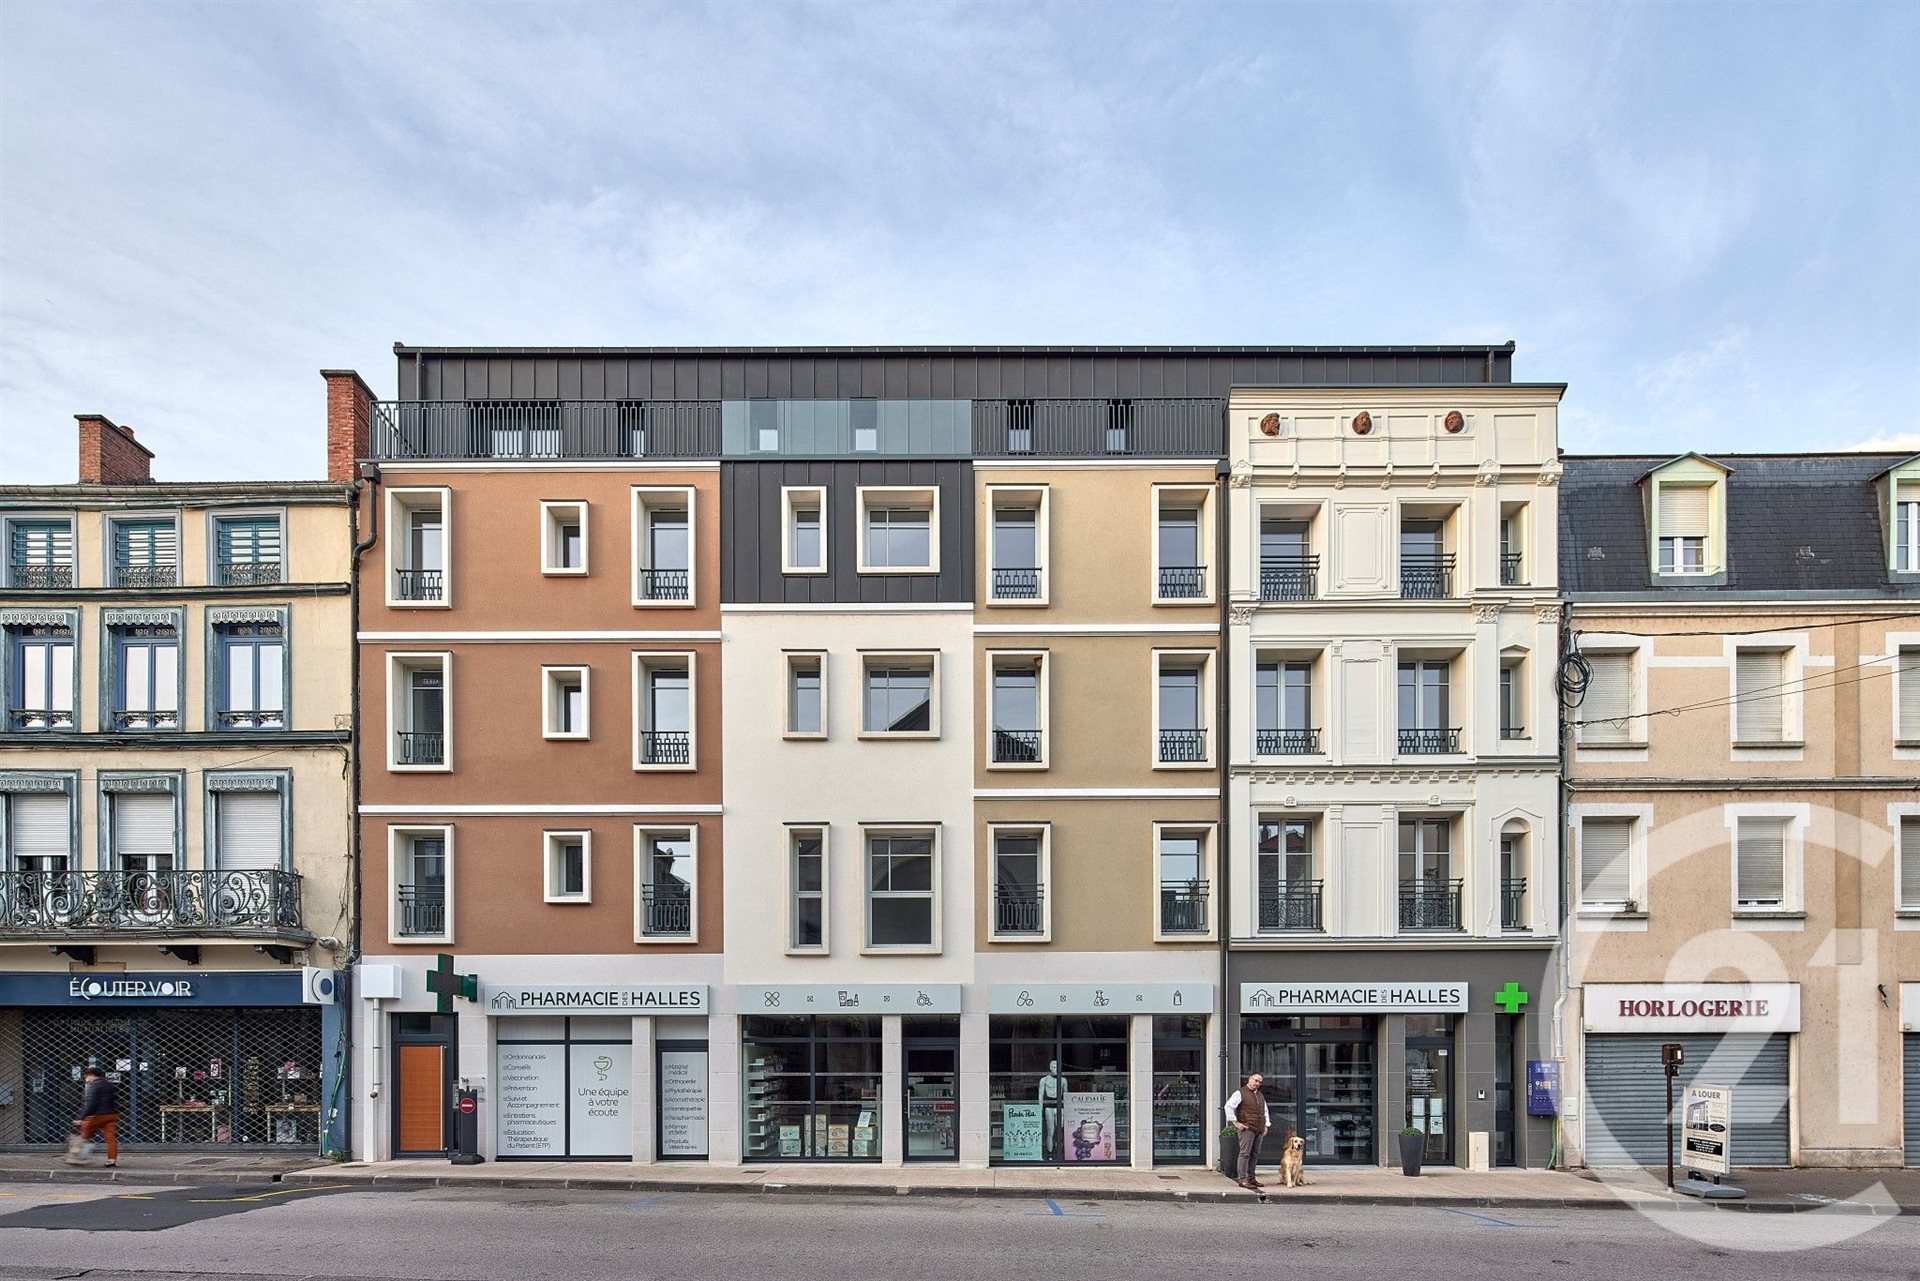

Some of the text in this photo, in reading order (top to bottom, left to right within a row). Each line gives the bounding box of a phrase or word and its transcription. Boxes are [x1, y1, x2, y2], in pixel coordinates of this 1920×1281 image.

[521, 991, 619, 1006] PHARMACIE
[631, 991, 700, 1006] HALLES
[1279, 989, 1378, 1004] PHARMACIE
[1390, 989, 1460, 1004] HALLES
[1618, 1000, 1769, 1018] HORLOGERIE
[577, 1087, 629, 1098] Une équipe
[1698, 1091, 1721, 1099] LOUER
[588, 1098, 595, 1106] à
[588, 1108, 619, 1116] écoute
